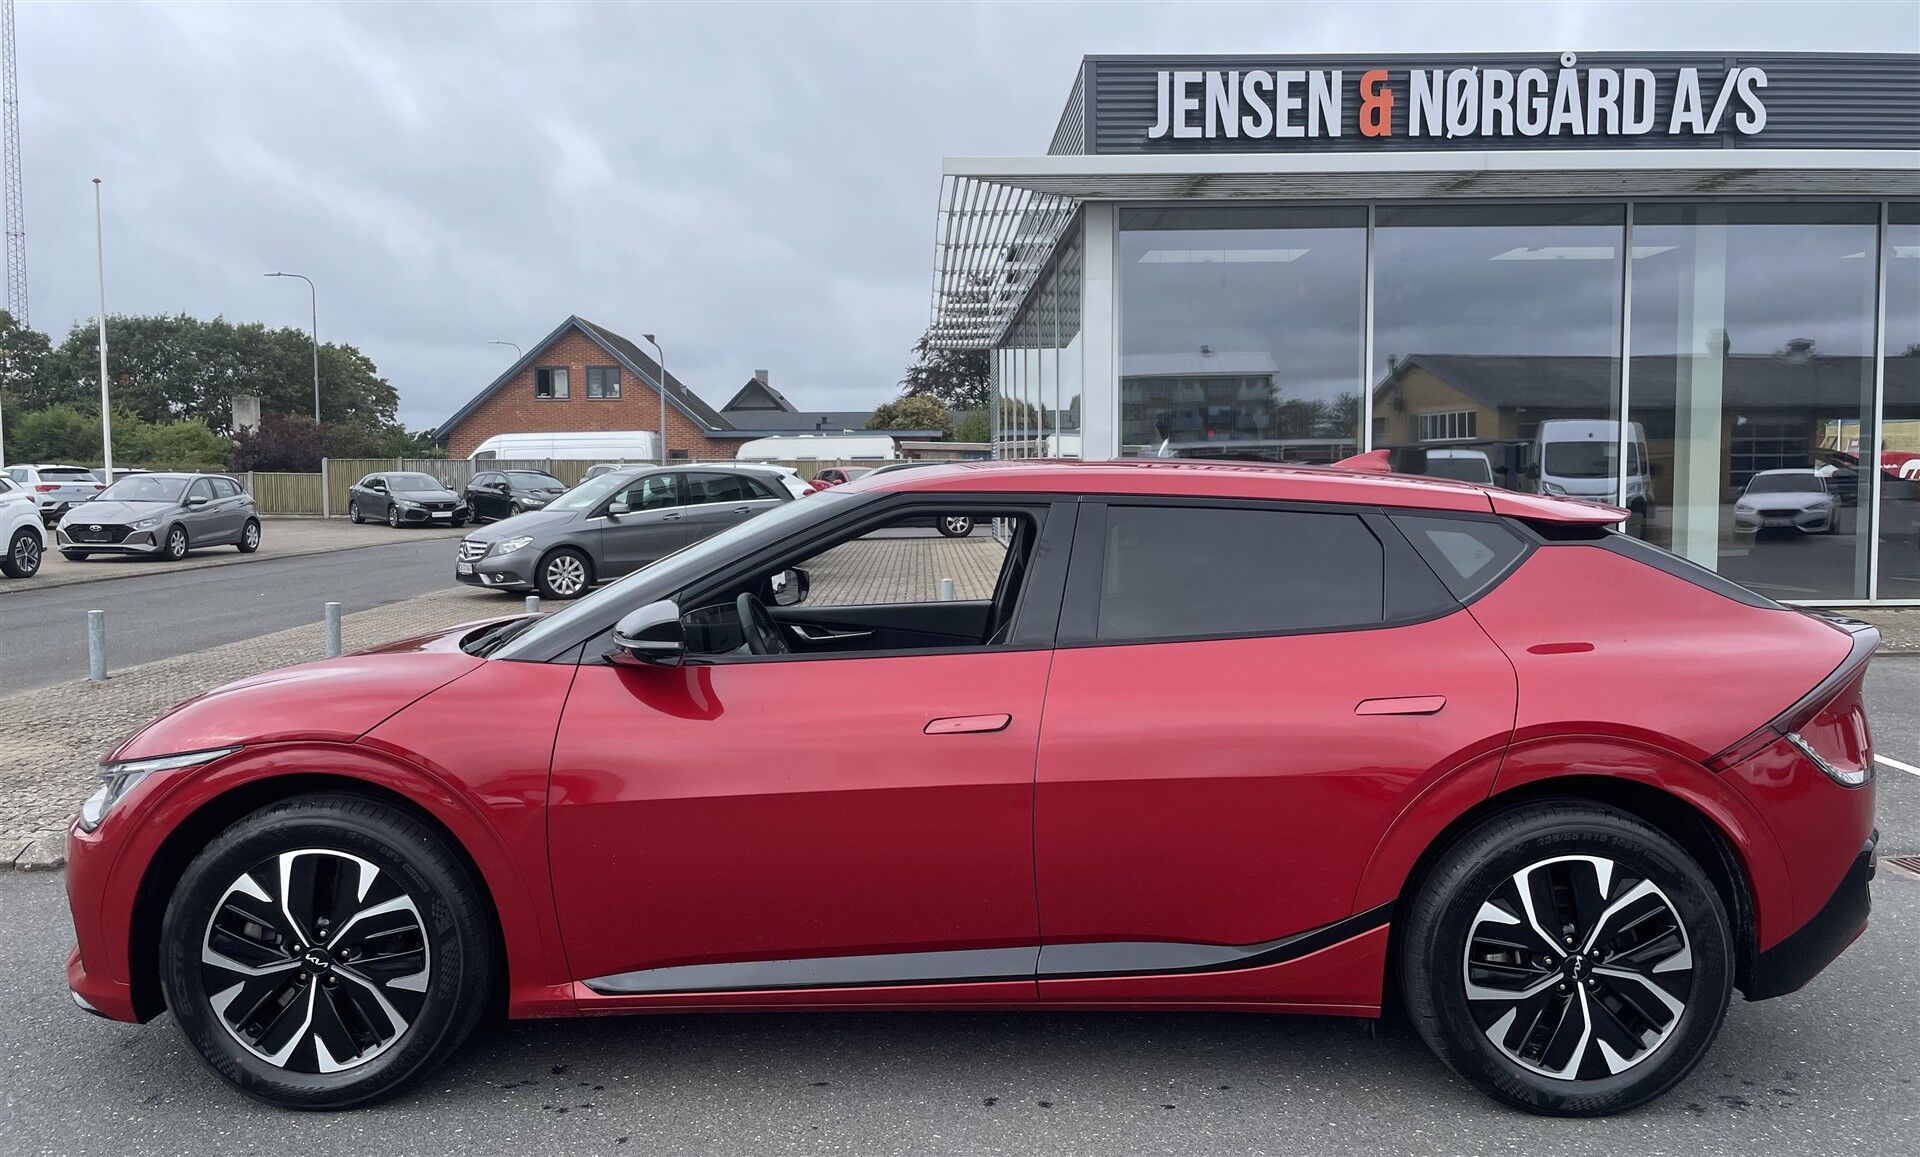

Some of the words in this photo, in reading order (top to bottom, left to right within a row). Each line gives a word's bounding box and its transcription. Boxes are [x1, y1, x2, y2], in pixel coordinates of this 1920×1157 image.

[1147, 69, 1343, 140] JENSEN
[1358, 69, 1394, 138] &
[1407, 51, 1656, 140] NØRGÅRD
[1668, 67, 1768, 136] A/S
